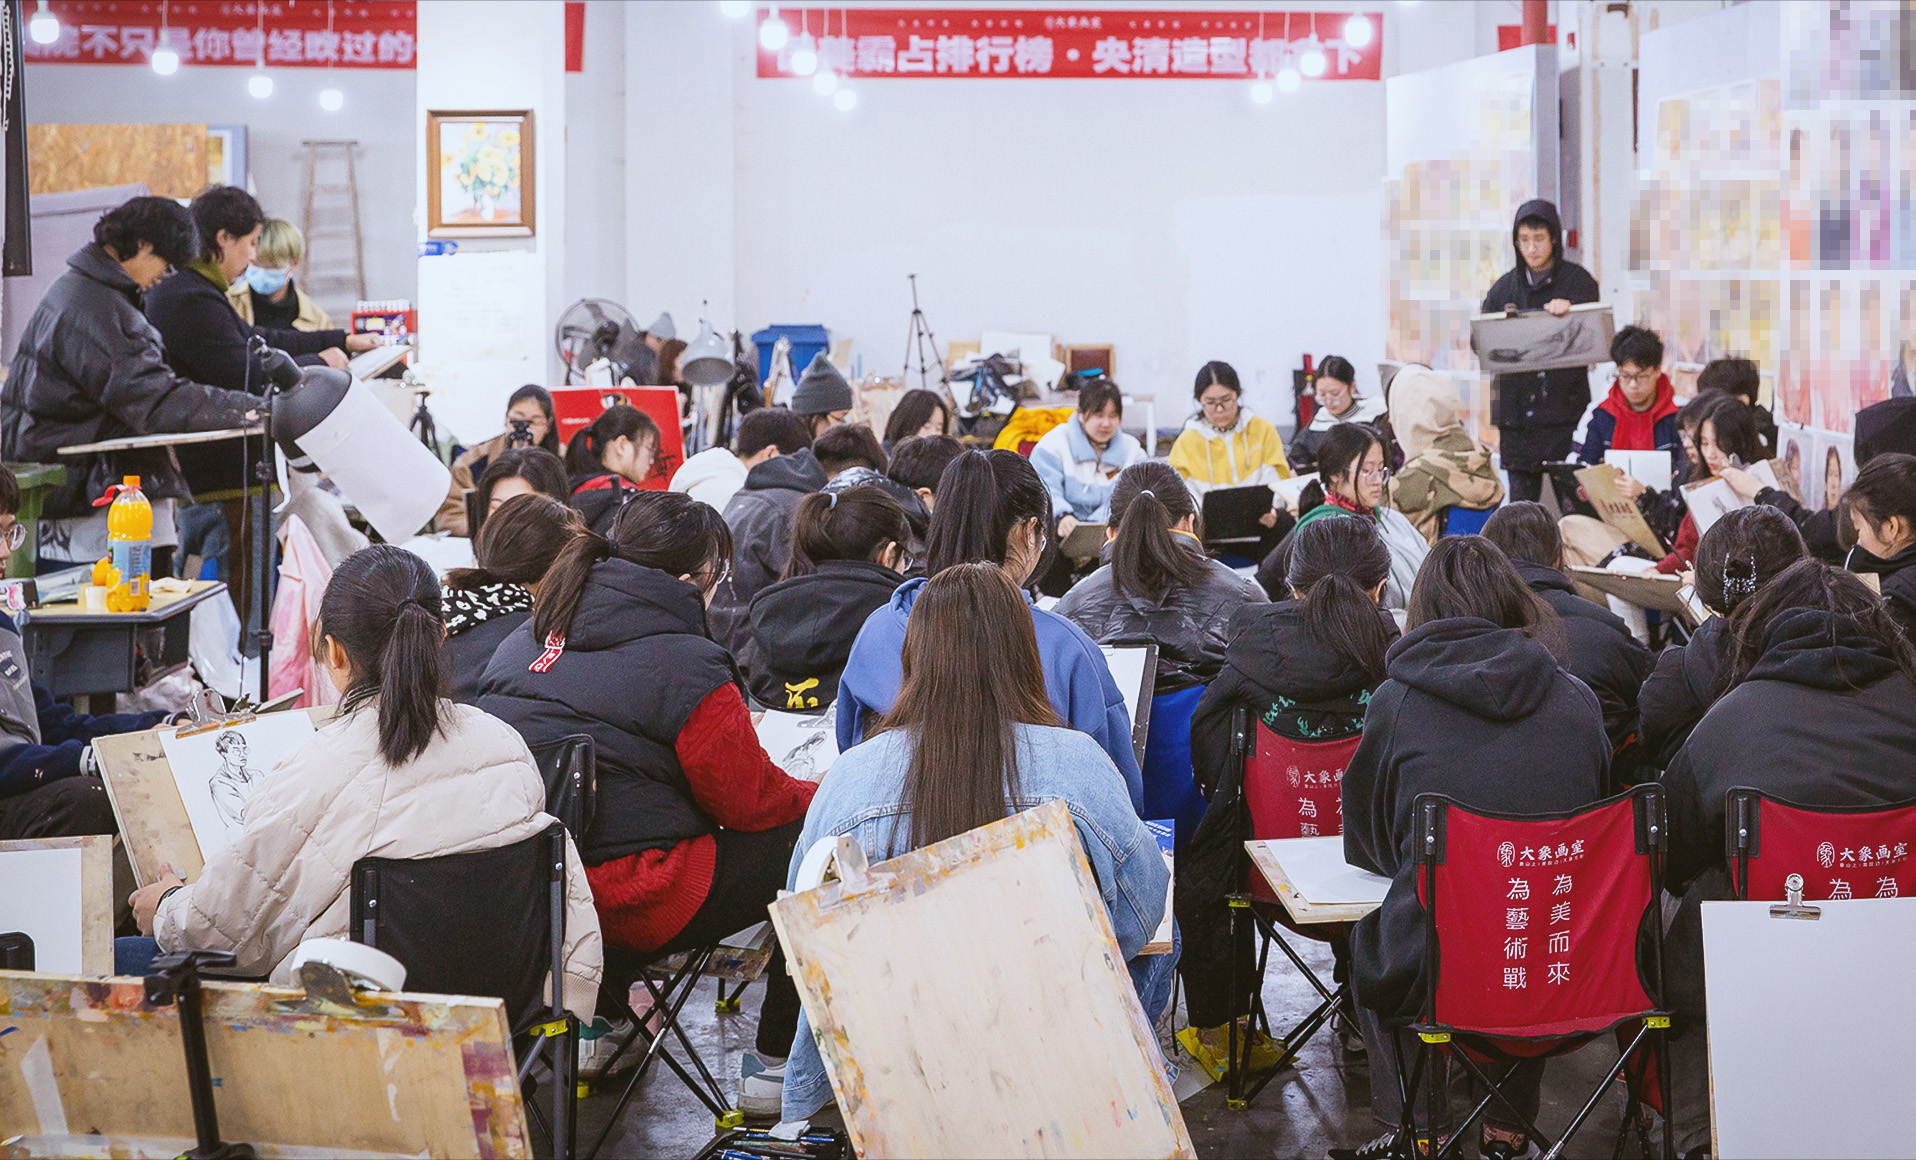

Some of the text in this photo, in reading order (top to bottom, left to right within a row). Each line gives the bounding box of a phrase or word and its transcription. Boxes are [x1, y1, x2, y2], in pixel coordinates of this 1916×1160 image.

[1519, 839, 1585, 861] 大象画室
[1839, 842, 1908, 862] 大象画室
[1502, 877, 1530, 990] 為藝術戰
[1547, 873, 1573, 986] 為美而來
